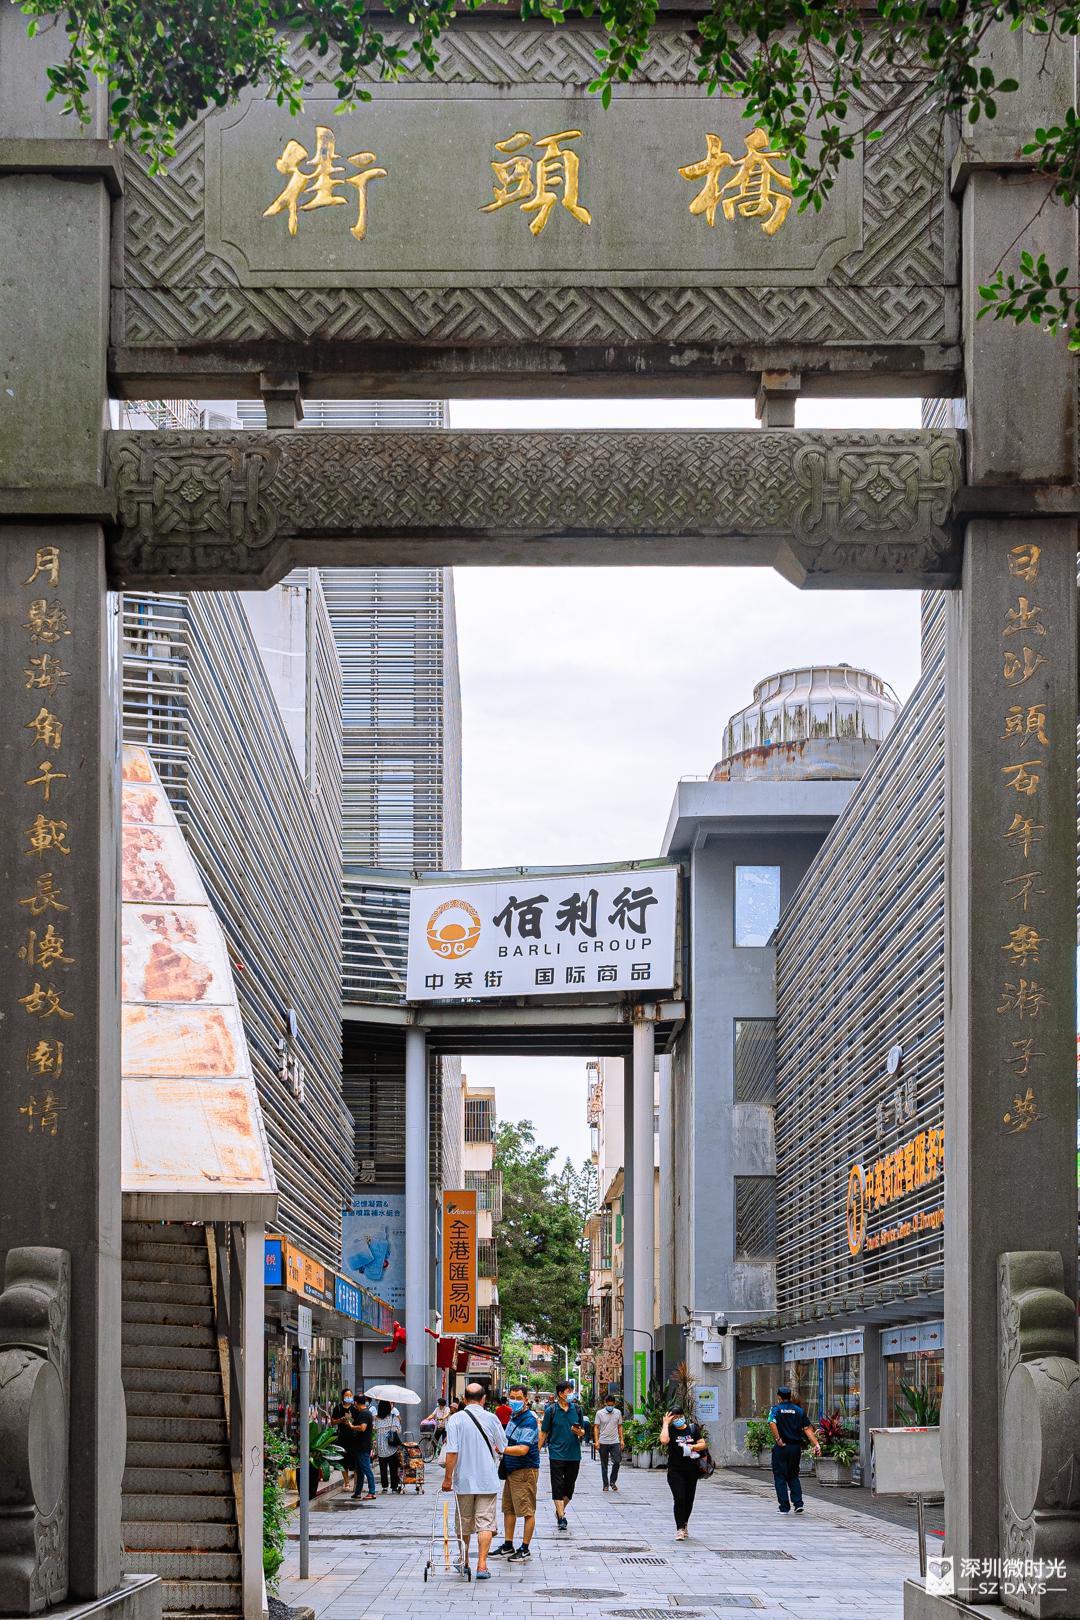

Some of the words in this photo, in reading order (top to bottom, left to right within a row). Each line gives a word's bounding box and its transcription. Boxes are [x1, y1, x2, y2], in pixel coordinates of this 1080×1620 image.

[492, 886, 659, 940] 佰利行
[498, 943, 561, 958] BARLI
[578, 937, 652, 953] GROUP
[424, 970, 503, 991] 中英街
[535, 963, 651, 986] 国际商品
[449, 1220, 470, 1324] 全港匯易购
